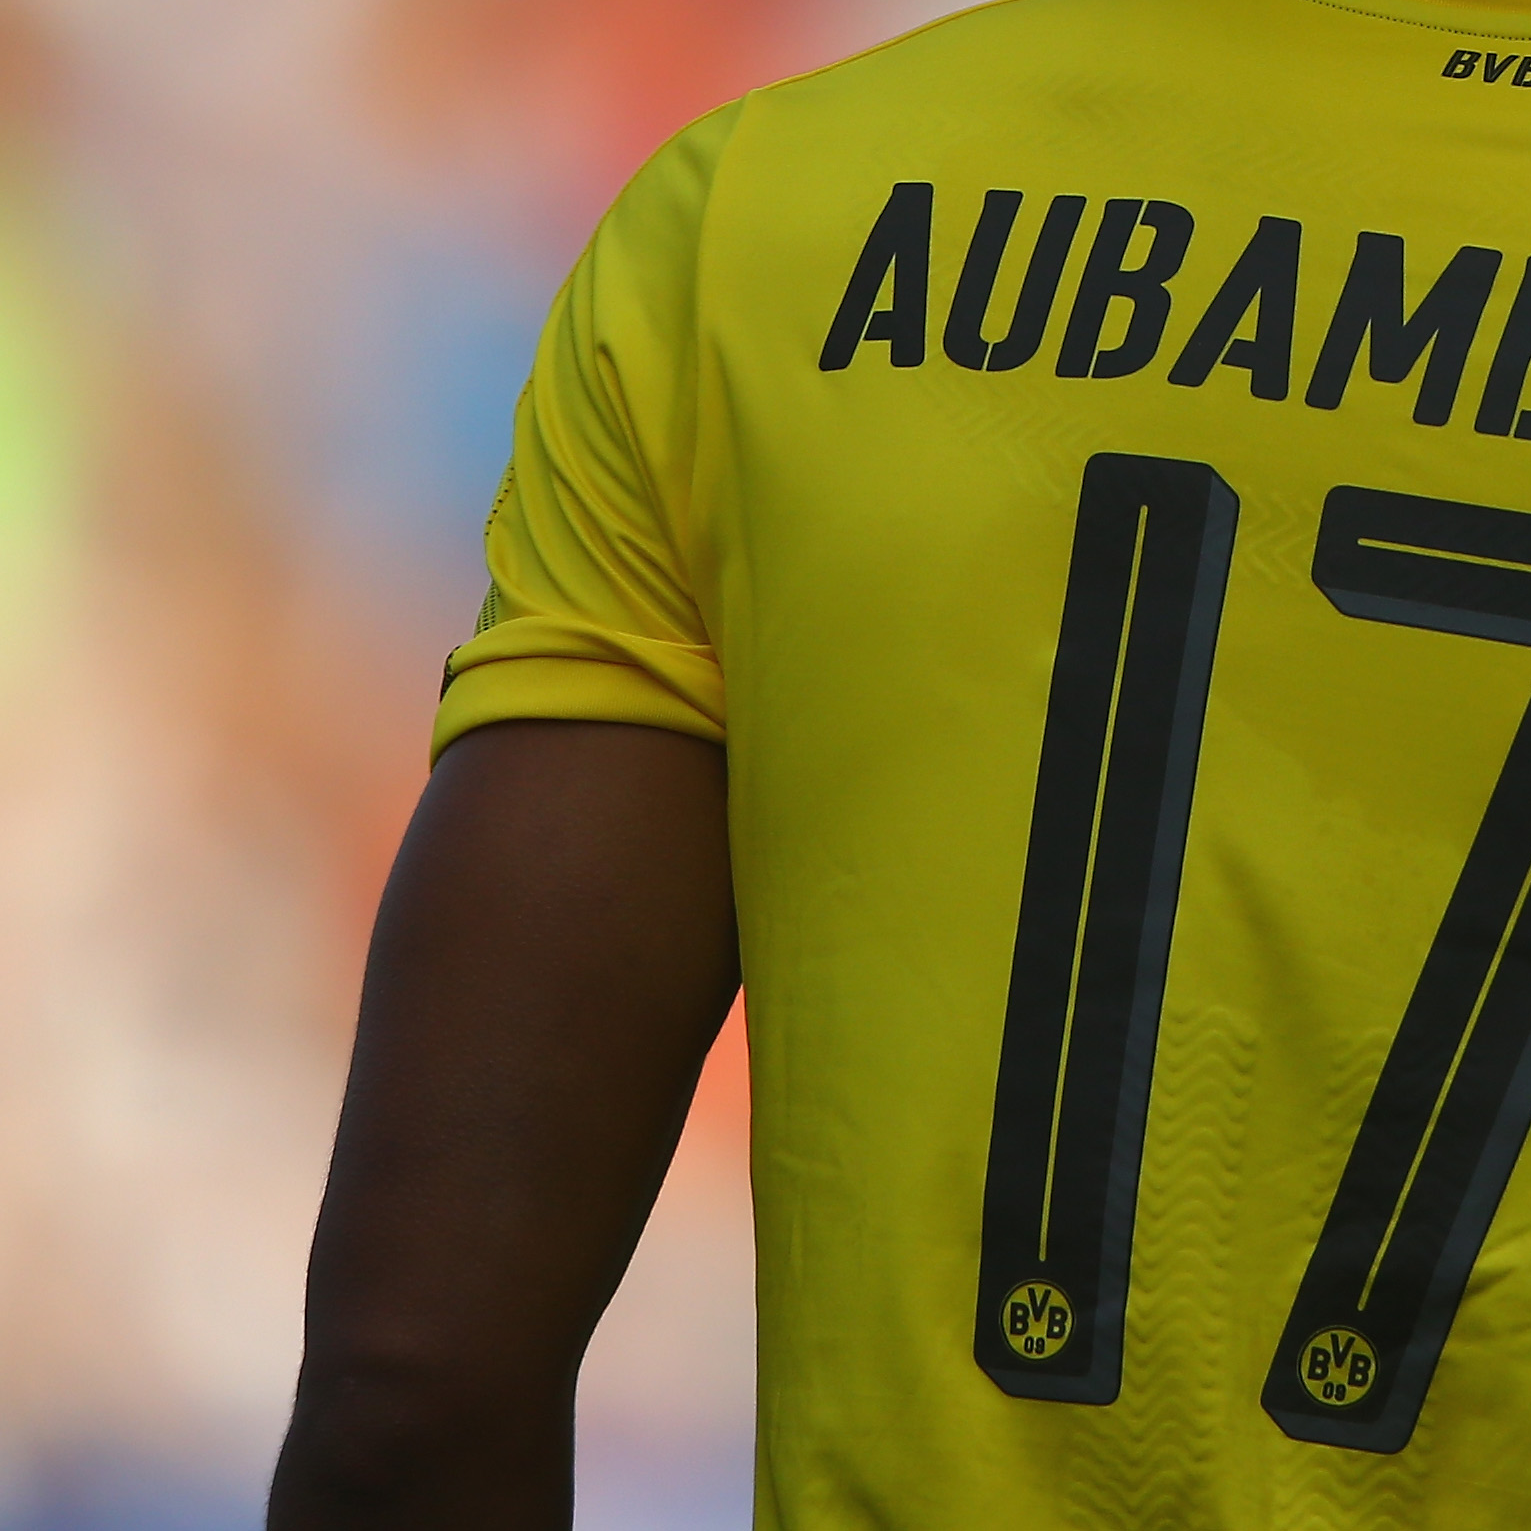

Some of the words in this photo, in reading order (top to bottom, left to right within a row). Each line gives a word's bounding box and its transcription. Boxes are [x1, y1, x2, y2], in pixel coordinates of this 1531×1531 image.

[1009, 1287, 1068, 1339] BVB
[1024, 1336, 1045, 1355] 09
[1307, 1333, 1371, 1387] BVB
[1322, 1382, 1347, 1402] 09
